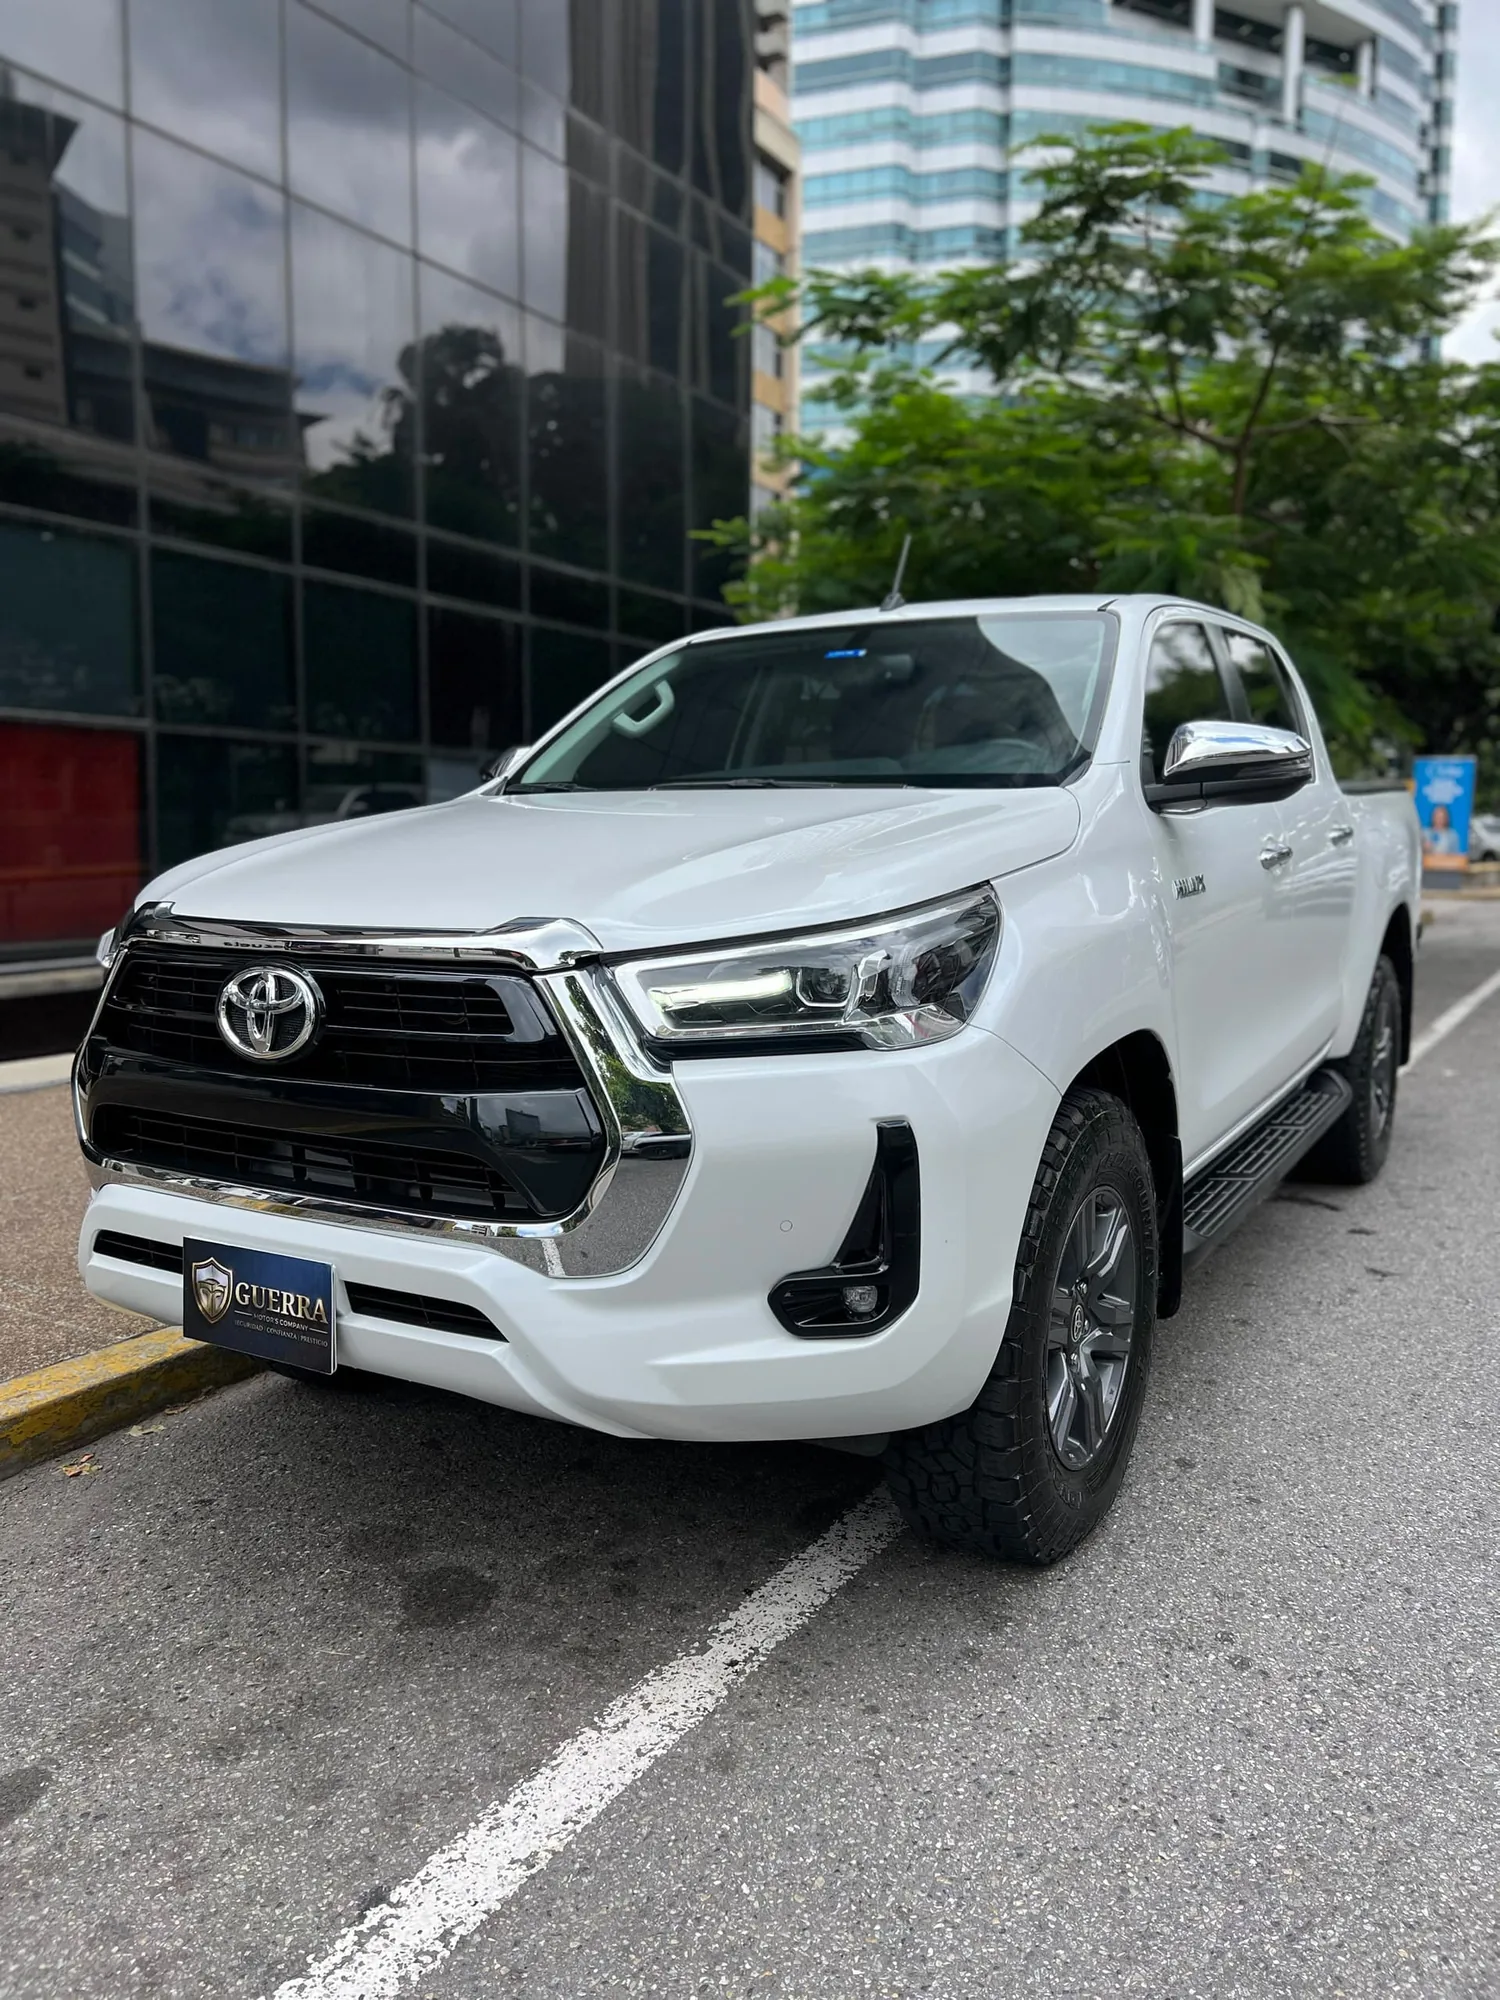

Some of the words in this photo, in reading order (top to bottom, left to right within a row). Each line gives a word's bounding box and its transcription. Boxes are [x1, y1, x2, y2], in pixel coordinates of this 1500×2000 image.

[1172, 874, 1206, 900] HILUX
[235, 1282, 328, 1324] GUERRA
[253, 1313, 279, 1325] MOTOR'S
[279, 1319, 309, 1332] COMPANY
[266, 1327, 298, 1340] CONFIANZA
[300, 1335, 328, 1348] PRESTIGIO
